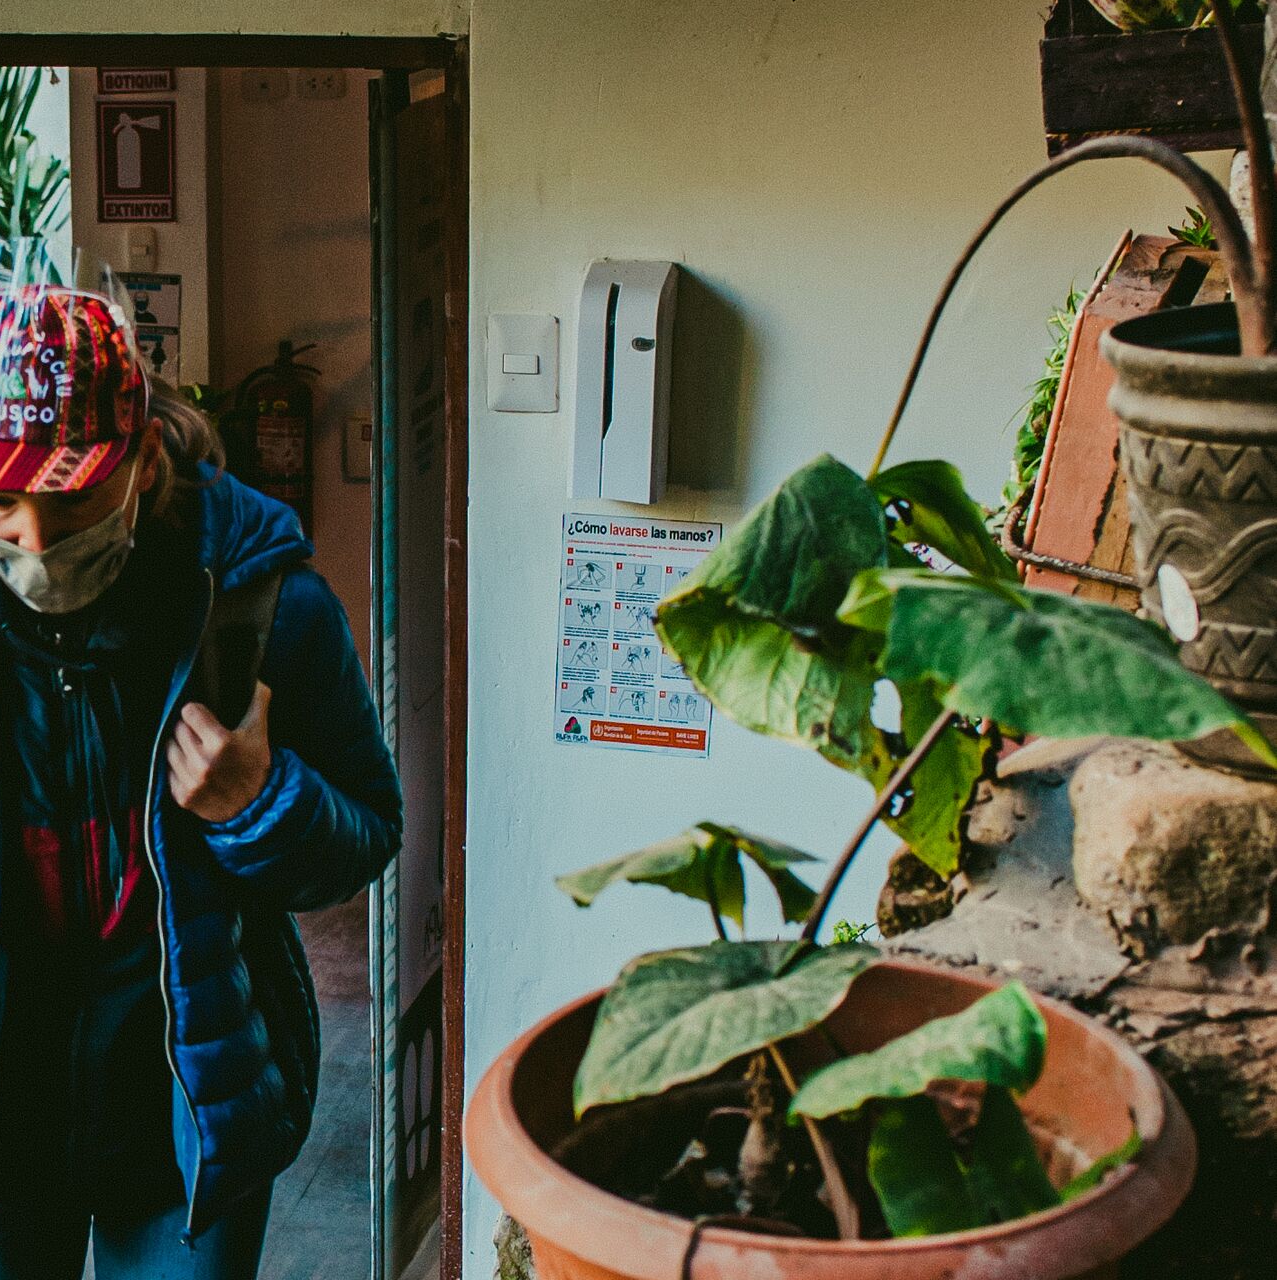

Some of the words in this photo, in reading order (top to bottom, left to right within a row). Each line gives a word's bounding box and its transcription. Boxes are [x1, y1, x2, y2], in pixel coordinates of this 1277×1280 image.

[106, 72, 168, 90] BOTIQUIN
[106, 202, 170, 218] EXTINTOR
[568, 520, 607, 535] ¿Cómo
[610, 523, 648, 538] lavarse
[651, 526, 667, 539] las
[669, 529, 714, 543] manos?
